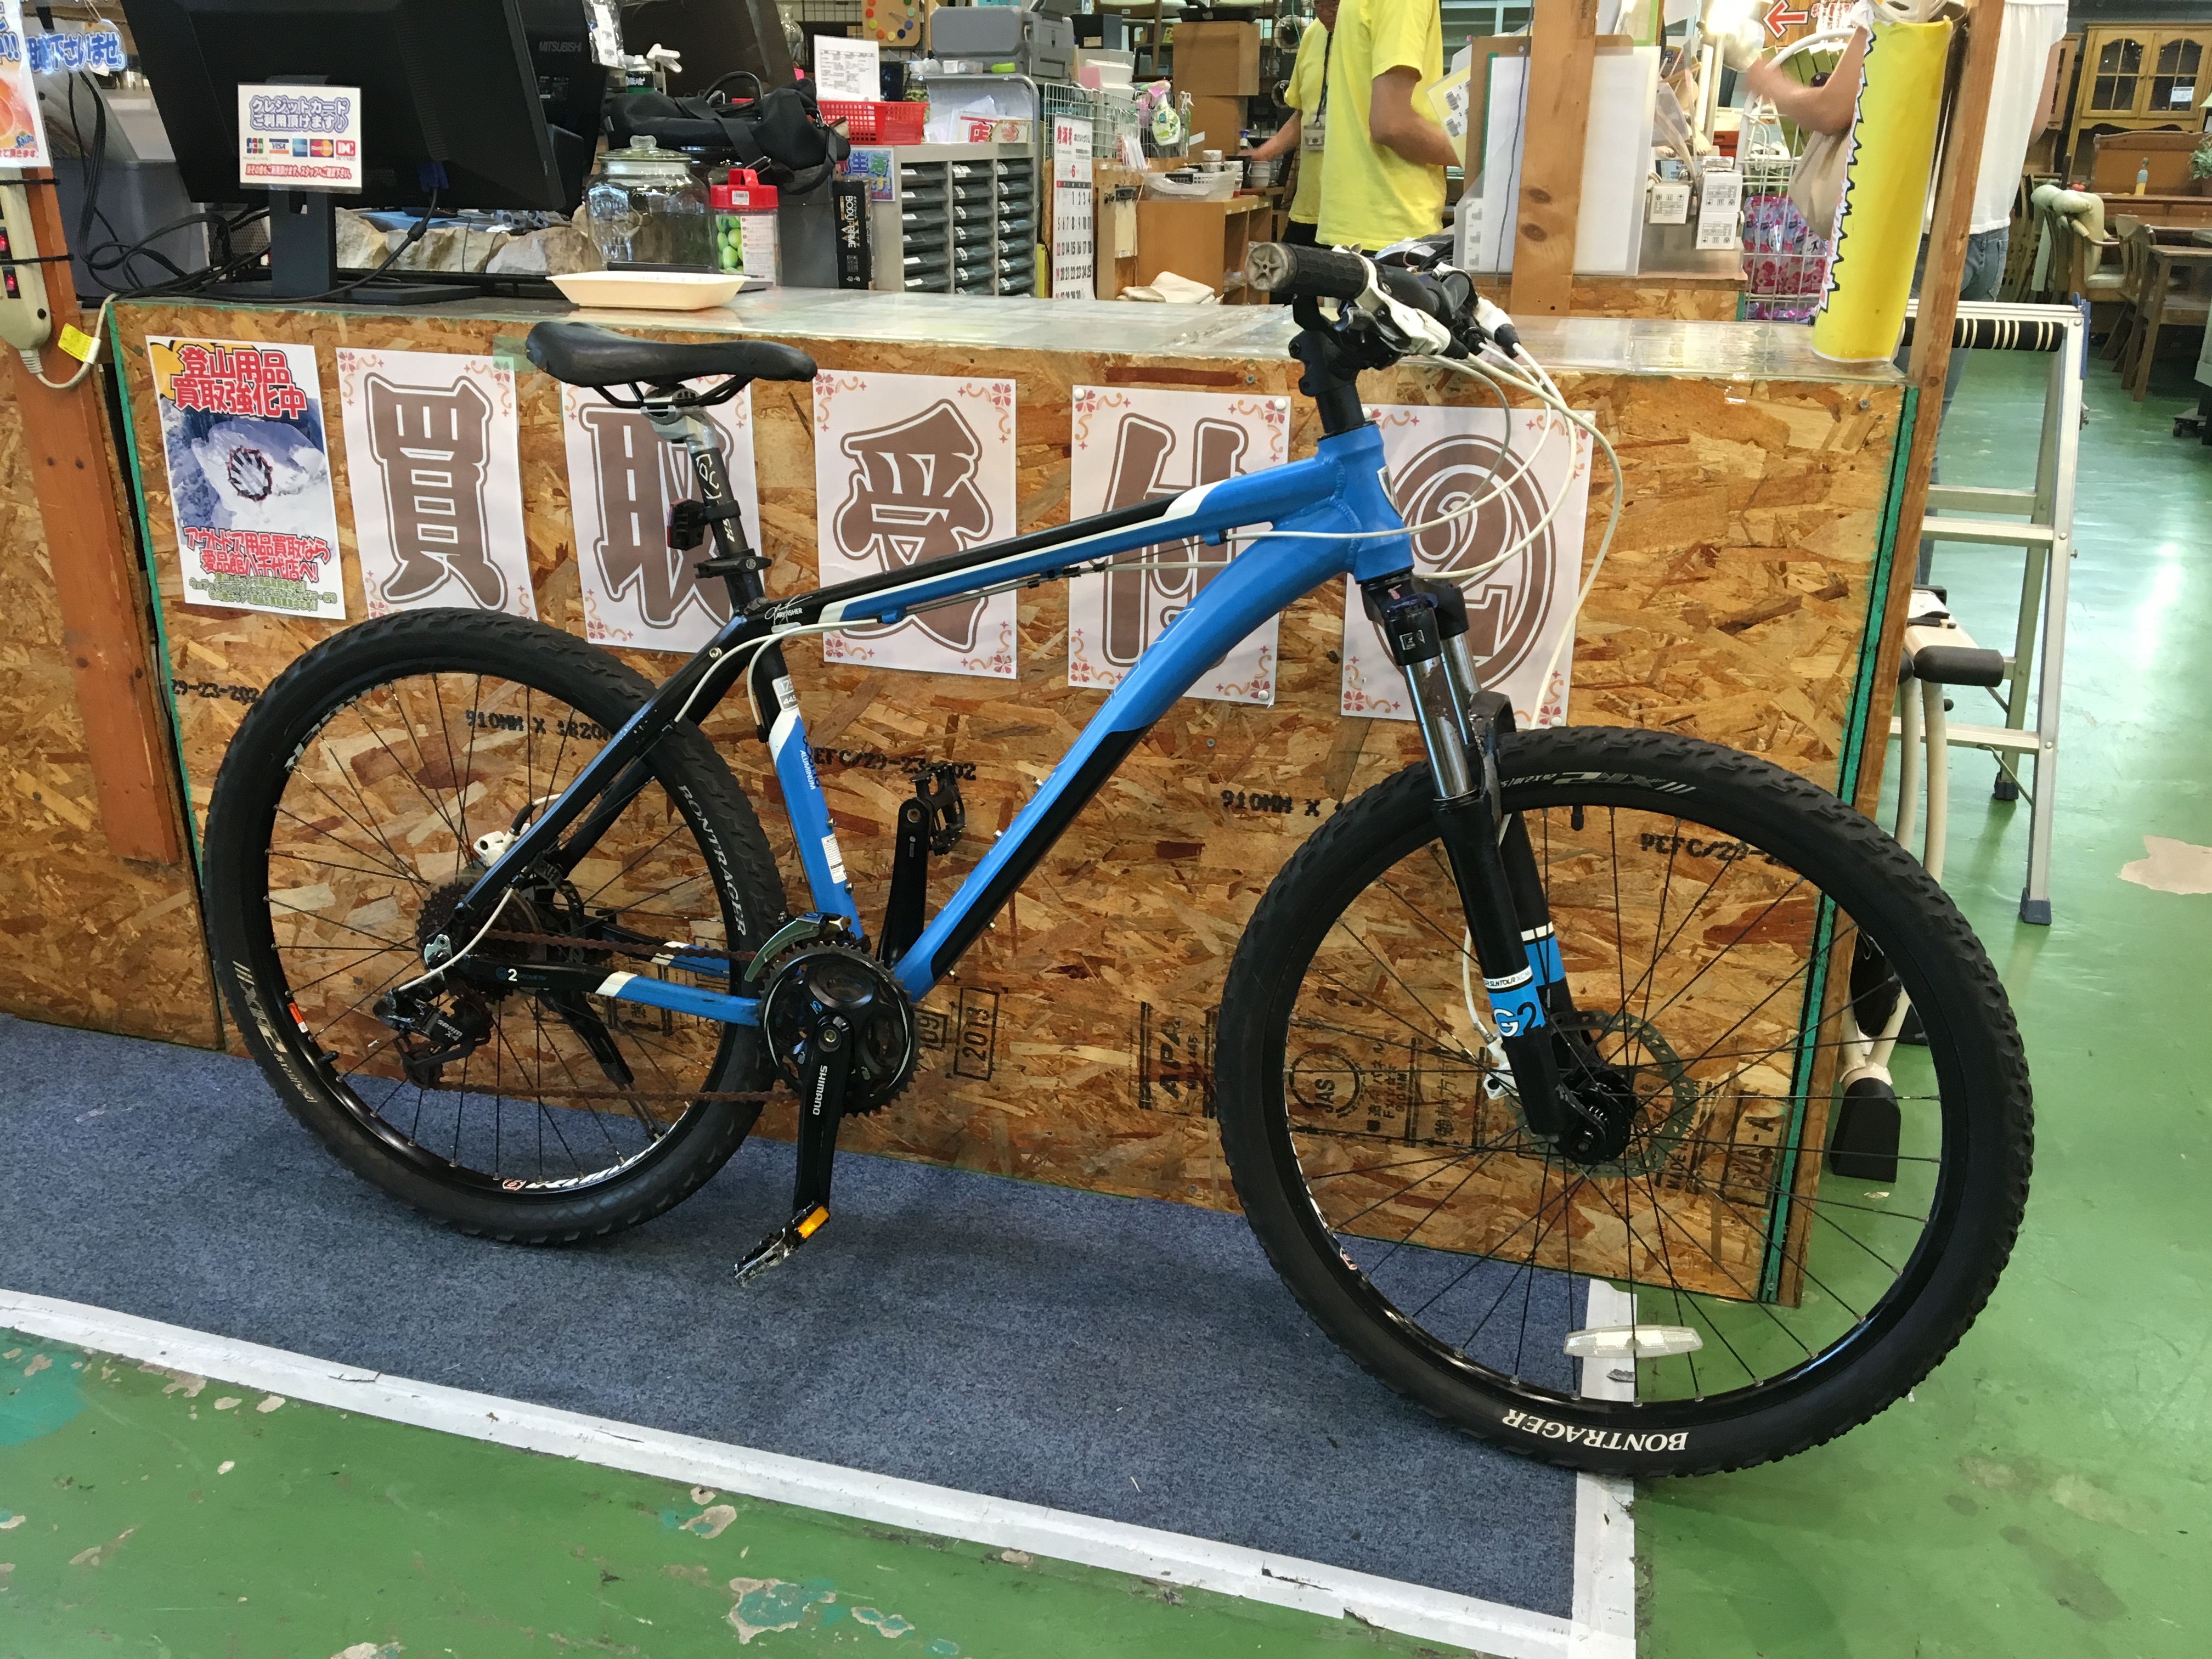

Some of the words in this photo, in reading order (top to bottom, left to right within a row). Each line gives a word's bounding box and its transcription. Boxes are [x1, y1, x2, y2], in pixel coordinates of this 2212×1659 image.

[539, 41, 583, 52] MITSUBISHI
[251, 97, 349, 115] クレジットカード
[1071, 164, 1076, 178] 6
[178, 346, 291, 384] 登山用品
[172, 376, 308, 420] 買取強化中
[364, 373, 509, 611] 買
[834, 399, 994, 652] 受
[184, 527, 331, 566] アウトドア用品買取なら
[200, 549, 319, 583] 愛品館八千代店へ!
[533, 716, 546, 735] X
[799, 749, 816, 791] ALUMINUM
[1221, 789, 1293, 814] 910MM
[1304, 799, 1320, 817] X
[678, 785, 746, 936] BONTRAGER
[436, 1018, 464, 1038] SRAM
[1493, 1001, 1543, 1037] G2
[1159, 1017, 1182, 1099] APA
[812, 1064, 829, 1116] SHIMANO
[1314, 1077, 1336, 1114] JAS
[1502, 1408, 1690, 1453] BONTRAGER
